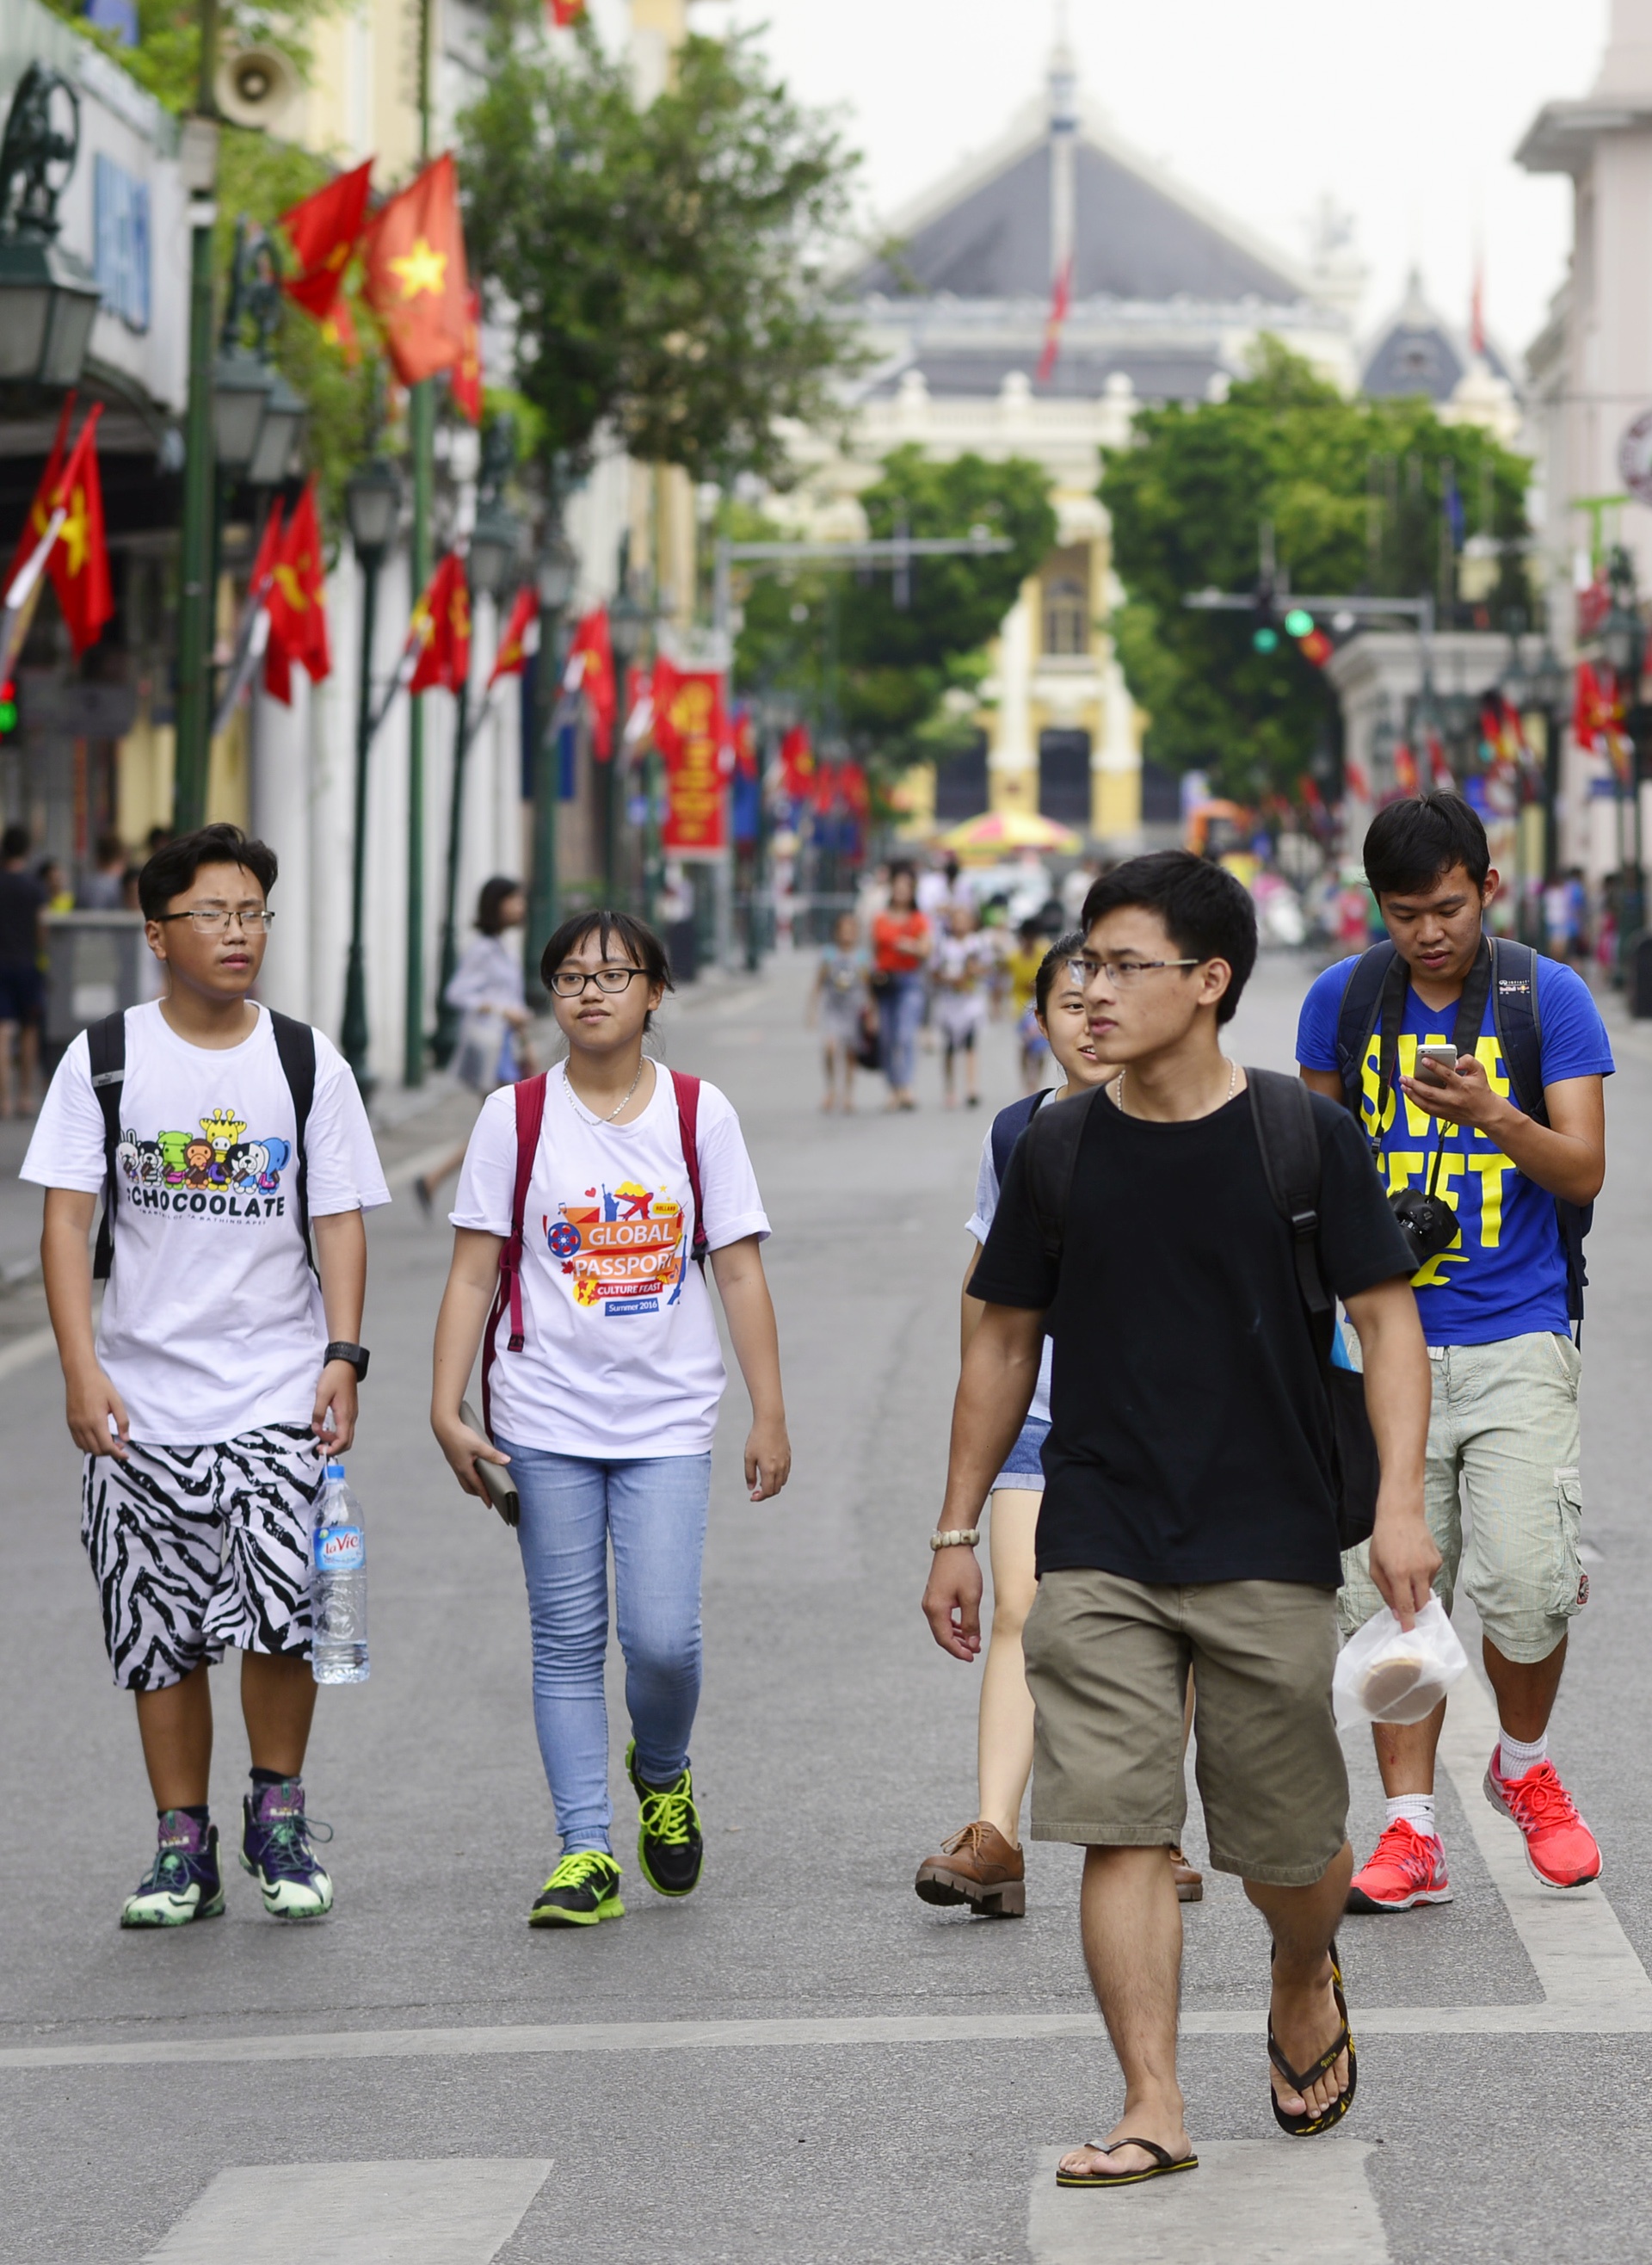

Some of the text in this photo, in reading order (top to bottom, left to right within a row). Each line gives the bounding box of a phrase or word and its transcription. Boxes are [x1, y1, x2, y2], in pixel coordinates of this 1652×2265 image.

[589, 1223, 674, 1246] GLOBAL
[574, 1251, 675, 1278] PASSPORT
[597, 1281, 662, 1295] CULTURE FEAST
[608, 1300, 658, 1312] Summer 2016
